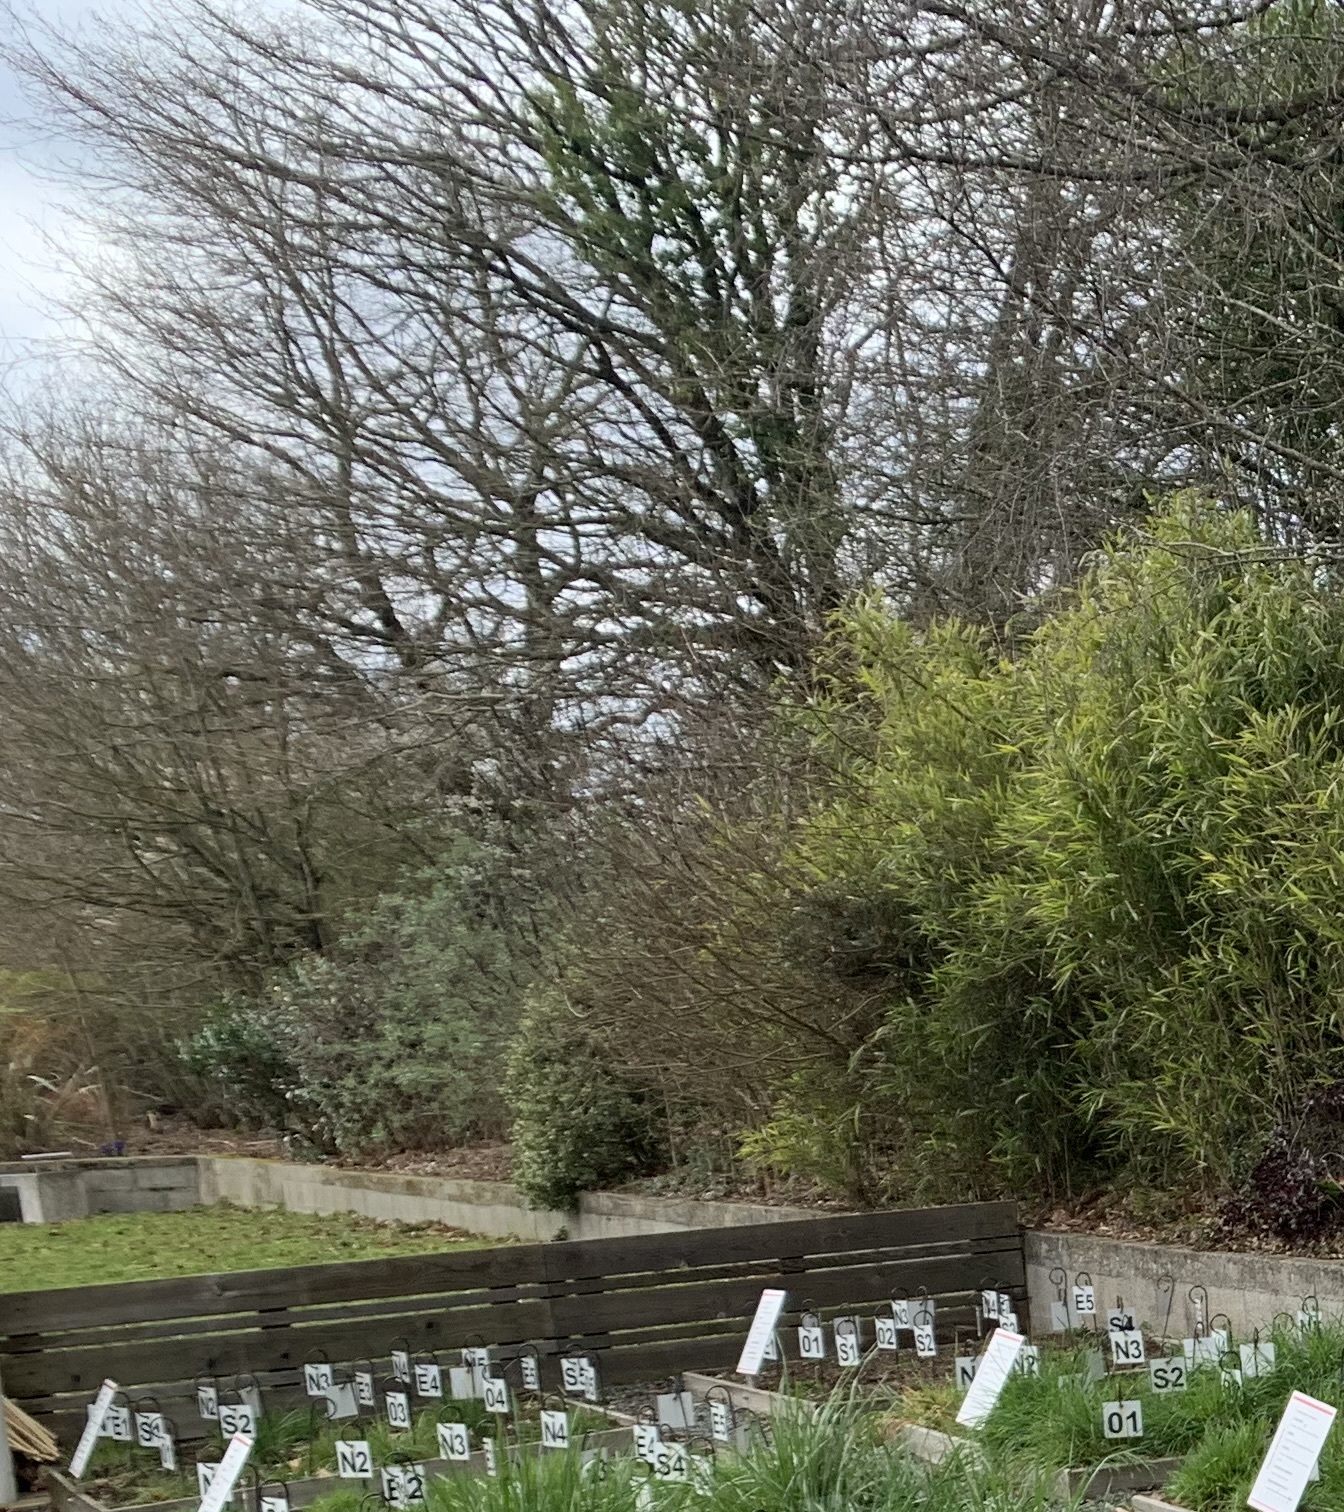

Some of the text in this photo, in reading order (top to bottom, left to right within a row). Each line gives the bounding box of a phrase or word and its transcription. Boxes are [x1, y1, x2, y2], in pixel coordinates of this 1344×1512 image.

[1076, 1294, 1094, 1311] E5
[802, 1335, 820, 1354] 01
[878, 1327, 894, 1345] 02
[917, 1333, 934, 1352] S2
[1115, 1339, 1142, 1360] N3
[308, 1373, 331, 1392] N3
[418, 1373, 439, 1393] E4
[1154, 1367, 1184, 1389] S2
[485, 1388, 505, 1408] 04
[389, 1402, 406, 1423] 03
[1108, 1411, 1138, 1434] 01
[223, 1414, 252, 1434] S2
[545, 1421, 566, 1443] N4
[441, 1433, 467, 1456] N3
[341, 1451, 369, 1473] N2
[658, 1452, 684, 1476] S4
[387, 1477, 423, 1501] E2
